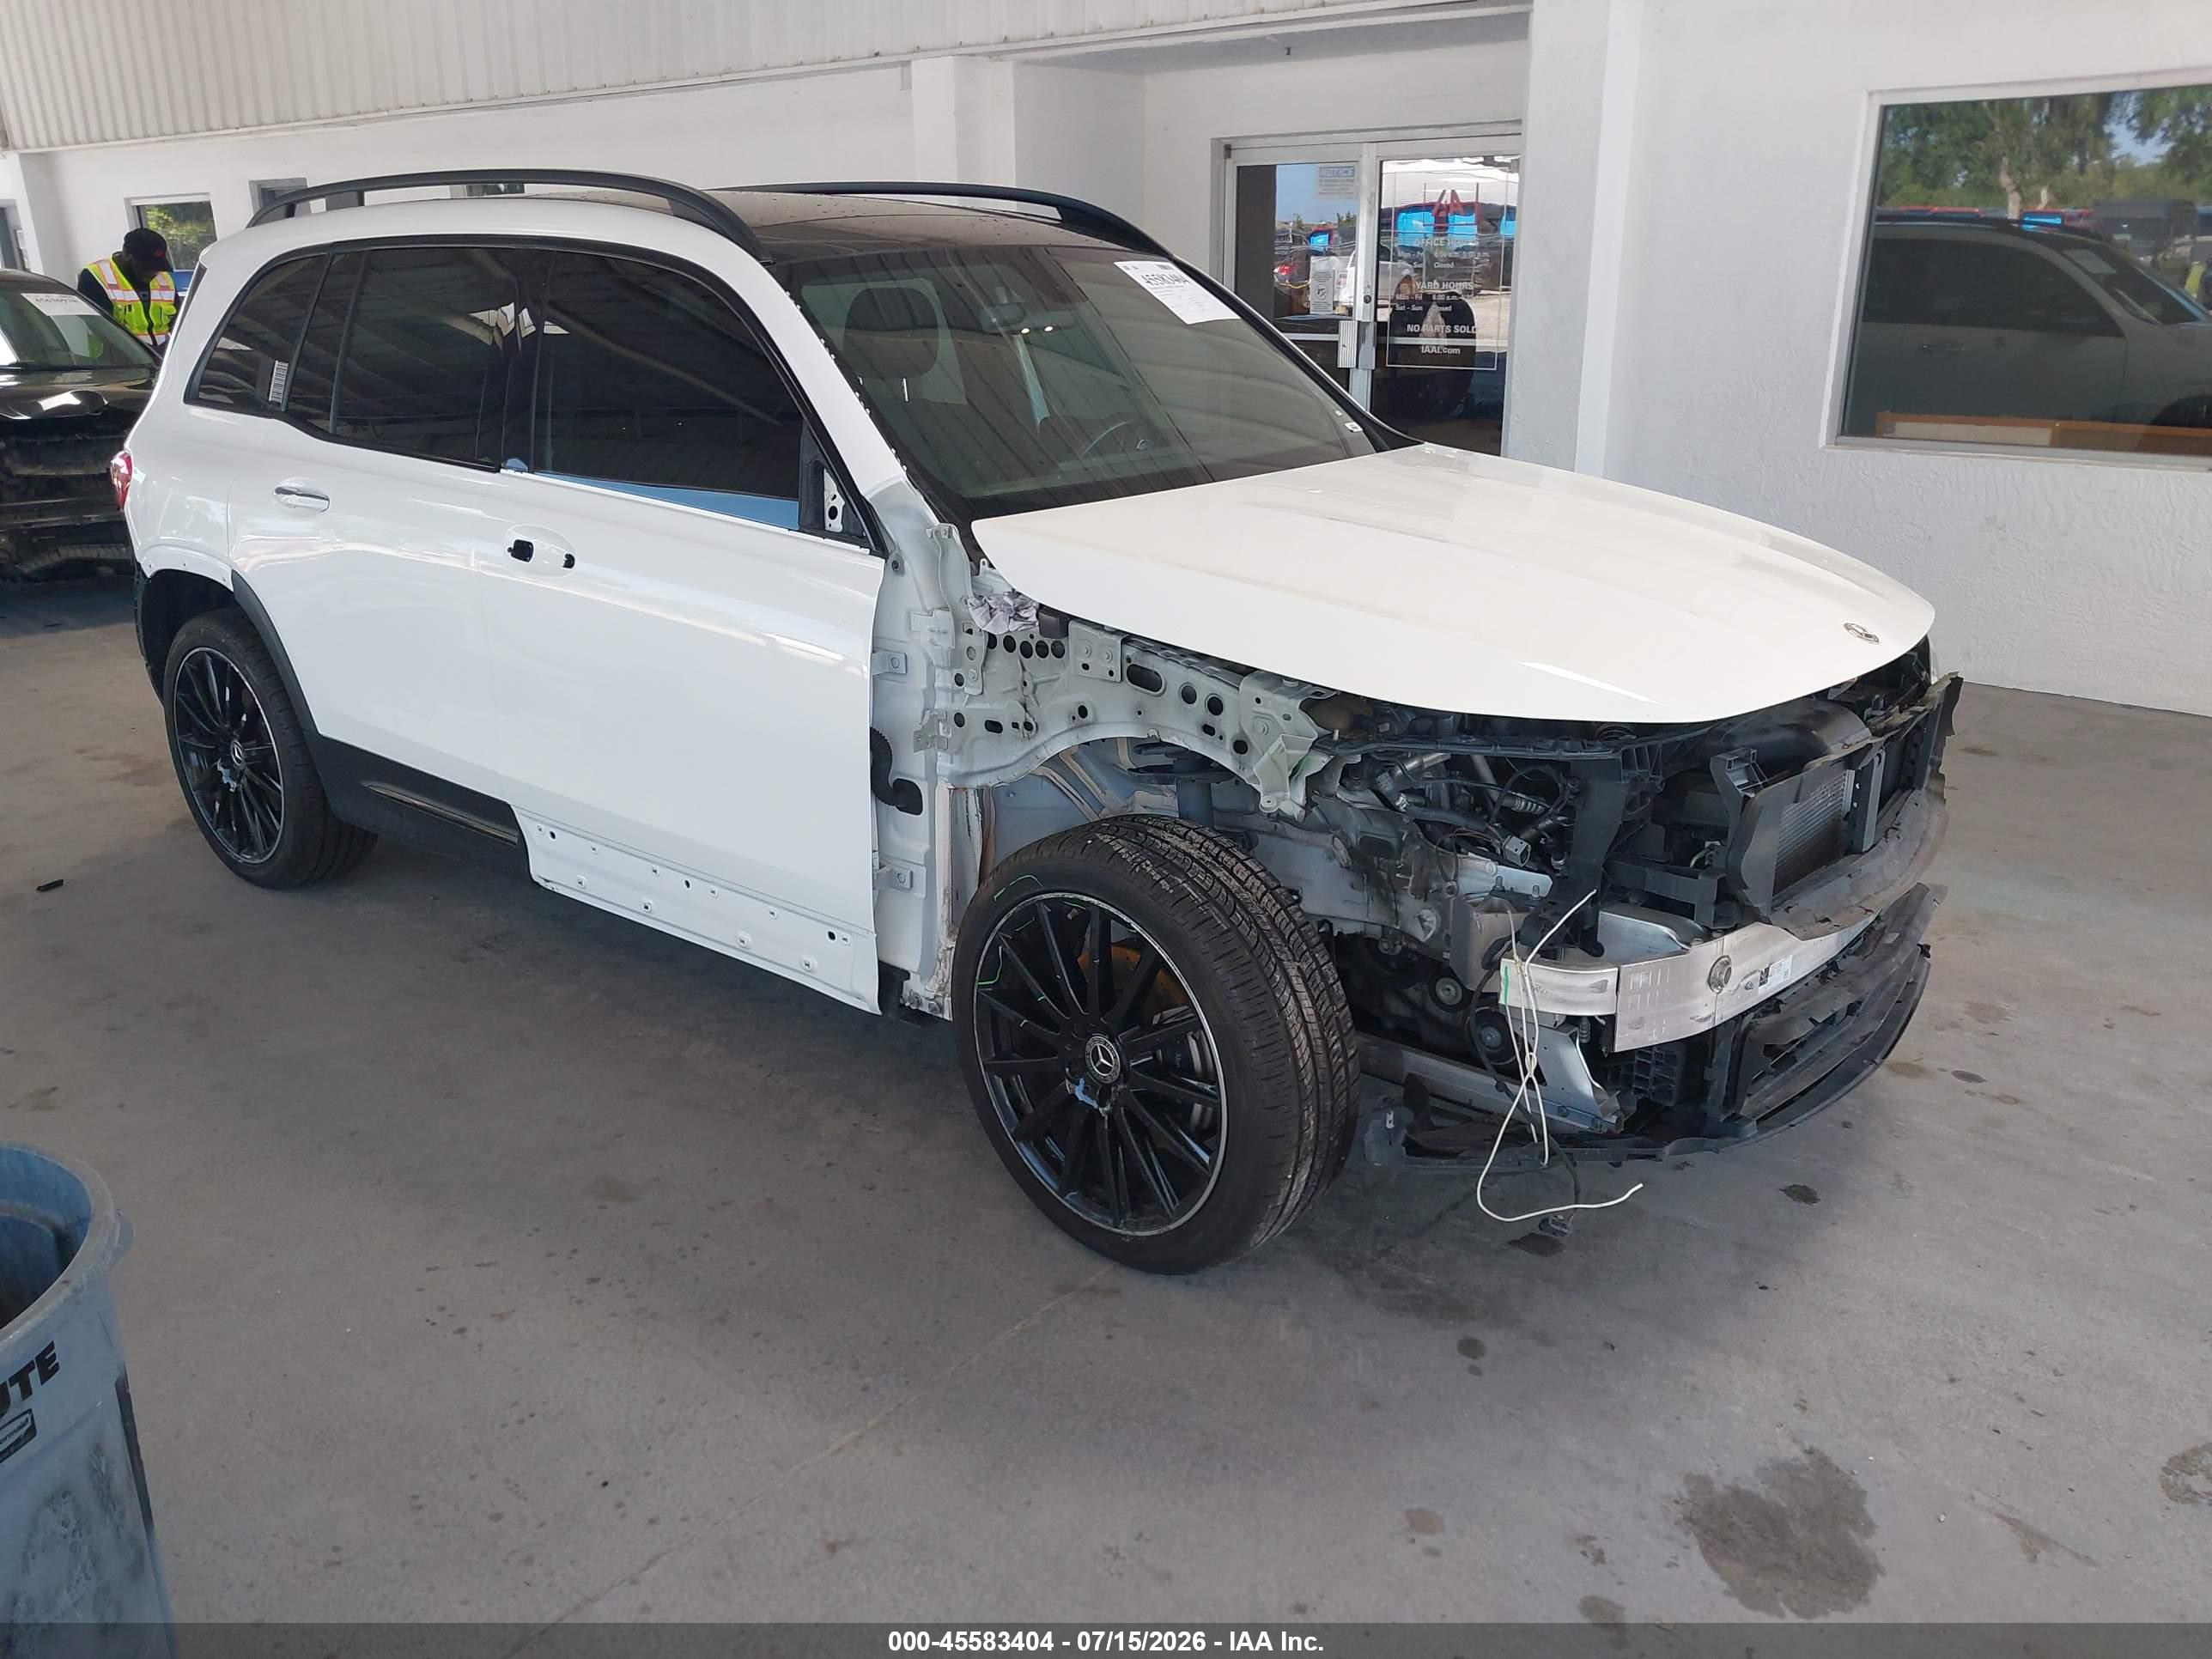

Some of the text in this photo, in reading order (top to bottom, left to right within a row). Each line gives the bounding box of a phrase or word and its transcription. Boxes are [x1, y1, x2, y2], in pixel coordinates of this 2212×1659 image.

[1415, 238, 1444, 246] OFFICE
[1442, 282, 1474, 290] HOURS
[1407, 324, 1420, 332] NO
[1453, 325, 1477, 334] SOLD
